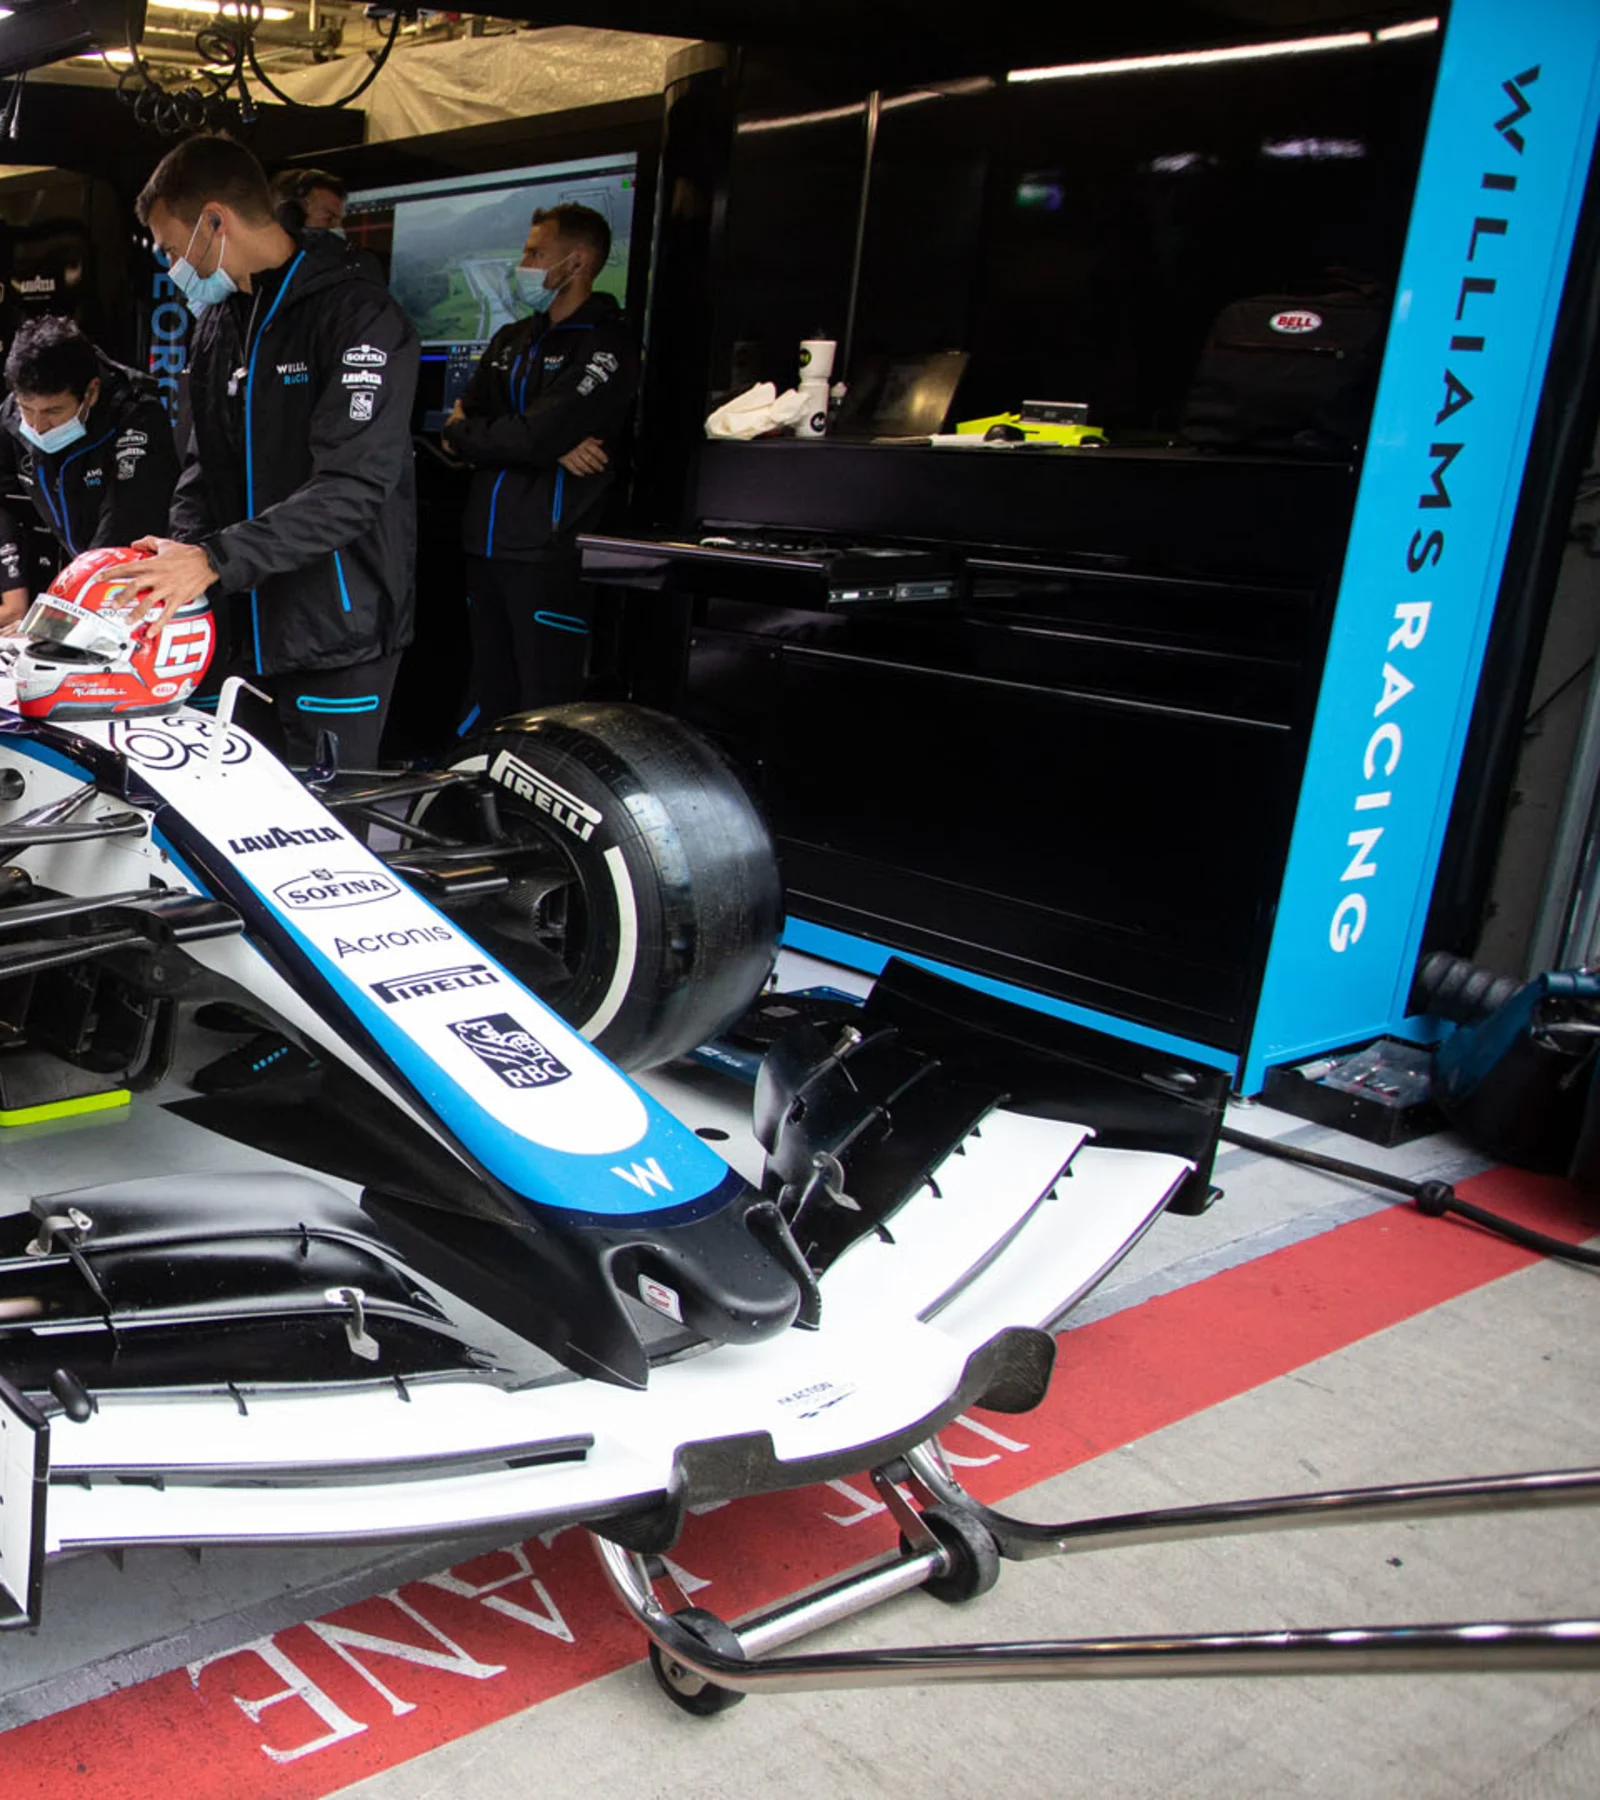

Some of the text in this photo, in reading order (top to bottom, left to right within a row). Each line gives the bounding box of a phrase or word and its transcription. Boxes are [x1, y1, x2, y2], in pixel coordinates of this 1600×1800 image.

[1277, 316, 1313, 327] BELL
[1329, 65, 1541, 952] WILLIAMS RACING
[109, 716, 252, 770] 63
[489, 749, 603, 842] PIRELLI
[228, 826, 345, 854] LAVAZZA
[288, 879, 389, 904] SOFINA
[333, 925, 453, 959] Acronis
[369, 964, 500, 1004] PIRELLI
[501, 1058, 570, 1088] RBC
